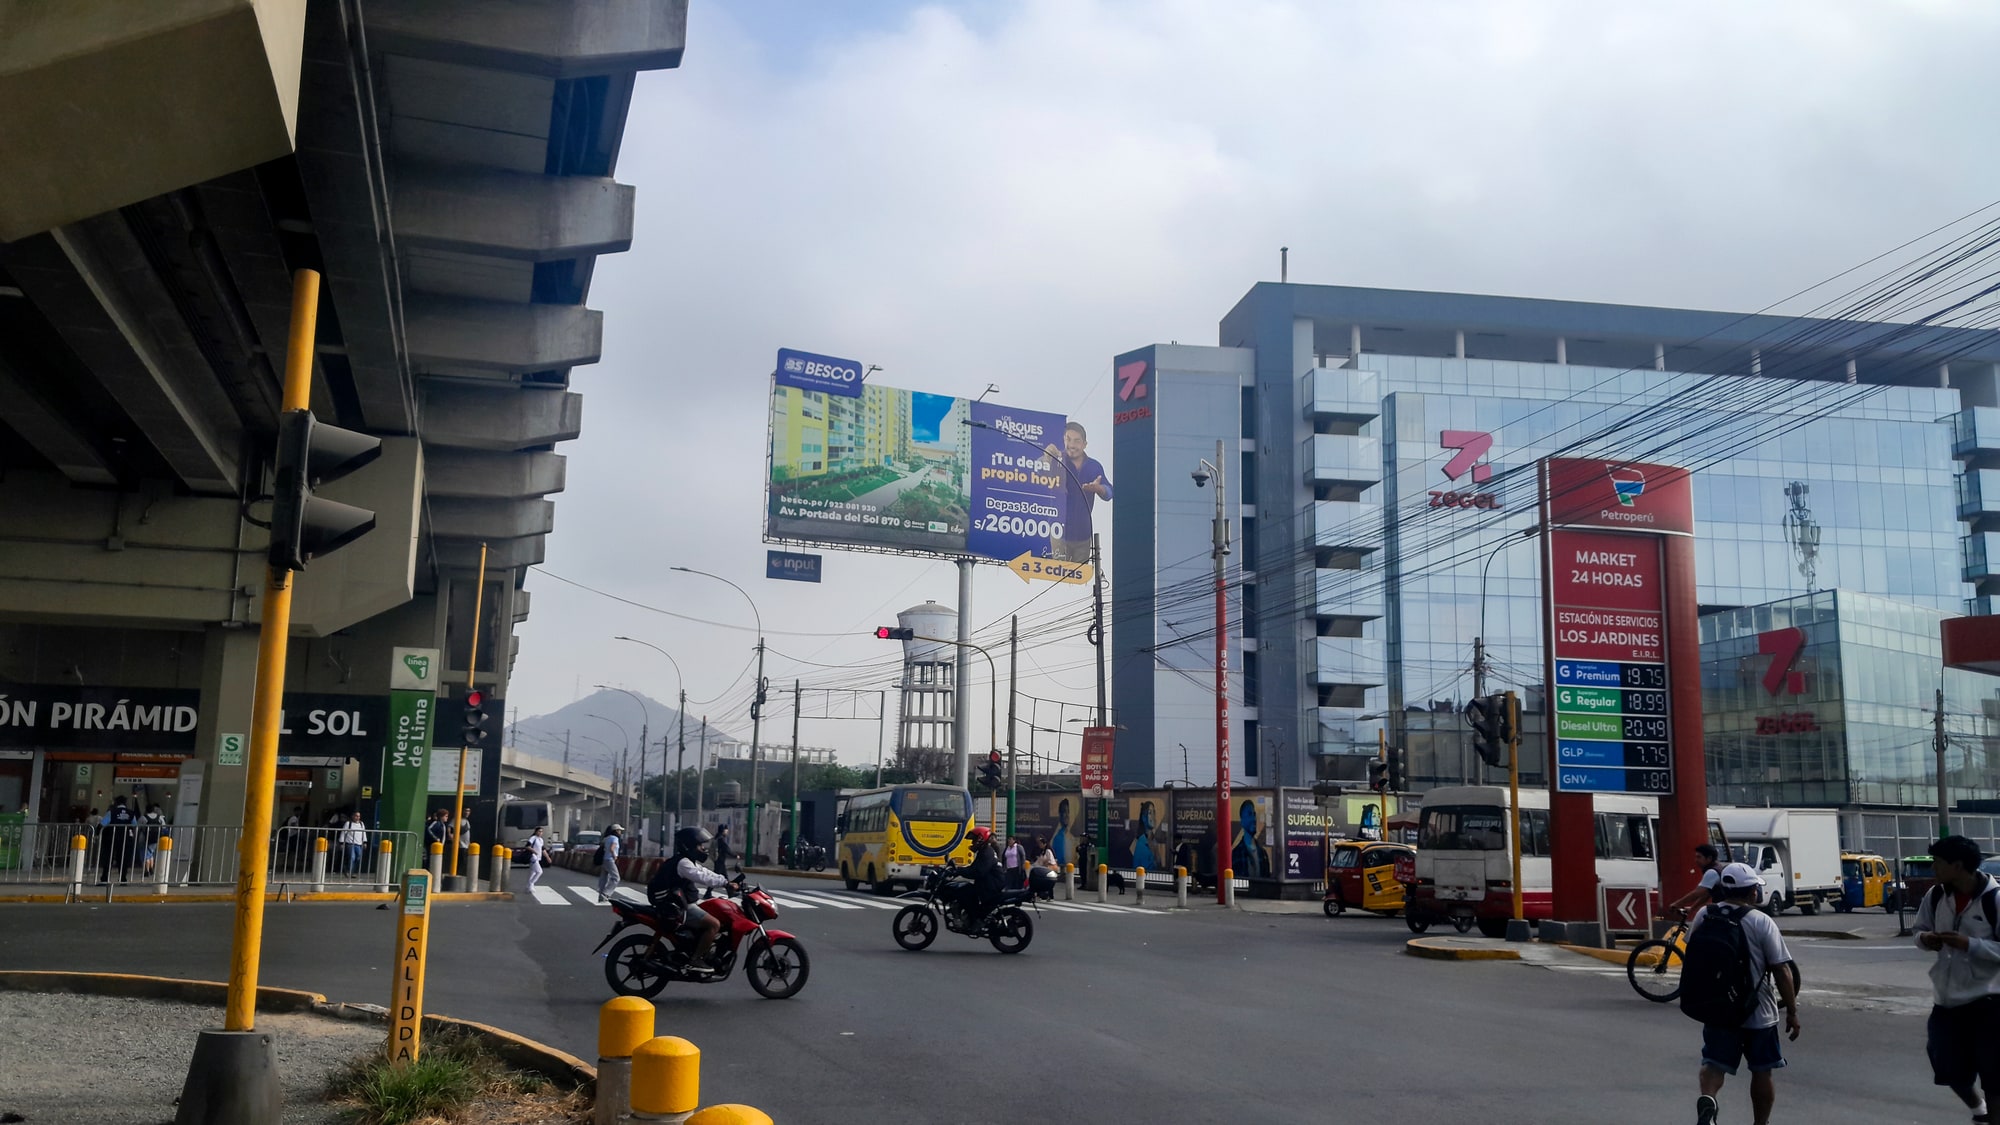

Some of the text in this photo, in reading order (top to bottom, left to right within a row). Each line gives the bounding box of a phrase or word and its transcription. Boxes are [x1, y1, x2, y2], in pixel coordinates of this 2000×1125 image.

[804, 361, 856, 382] BESCO
[995, 419, 1044, 436] PARQUES
[991, 452, 1051, 472] ¡Tu depa
[981, 467, 1060, 489] propio hoy!
[780, 495, 823, 507] besco.pe
[861, 504, 877, 512] 930
[986, 497, 1058, 517] Depas 3 dorm
[779, 506, 900, 527] Av. Portada del Sol 870
[1601, 509, 1655, 523] Petroperú
[784, 558, 815, 571] input
[1575, 550, 1637, 567] MARKET
[1021, 561, 1083, 580] a 3 cdras
[1571, 569, 1643, 588] 24 HORAS
[1559, 610, 1659, 628] ESTACIÓN DE SERVICIOS
[1559, 629, 1660, 647] LOS JARDINES
[419, 666, 427, 678] 1
[1559, 664, 1664, 686] G Premium 19.75
[1560, 690, 1665, 711] G Regular 18.99
[307, 709, 368, 736] SOL
[1221, 709, 1229, 728] DE
[408, 698, 428, 768] de Lima
[1561, 719, 1666, 738] Diesel Ultra 20.49
[225, 736, 239, 752] S
[392, 715, 410, 767] Metro
[1561, 747, 1584, 757] GLP
[1637, 745, 1668, 764] 7.75
[1562, 774, 1588, 784] GNV
[1643, 772, 1669, 789] 1.80
[1176, 808, 1216, 821] SUPÉRALO.
[1288, 812, 1335, 826] SUPÉRALO.
[397, 927, 419, 1061] CALIDDA
